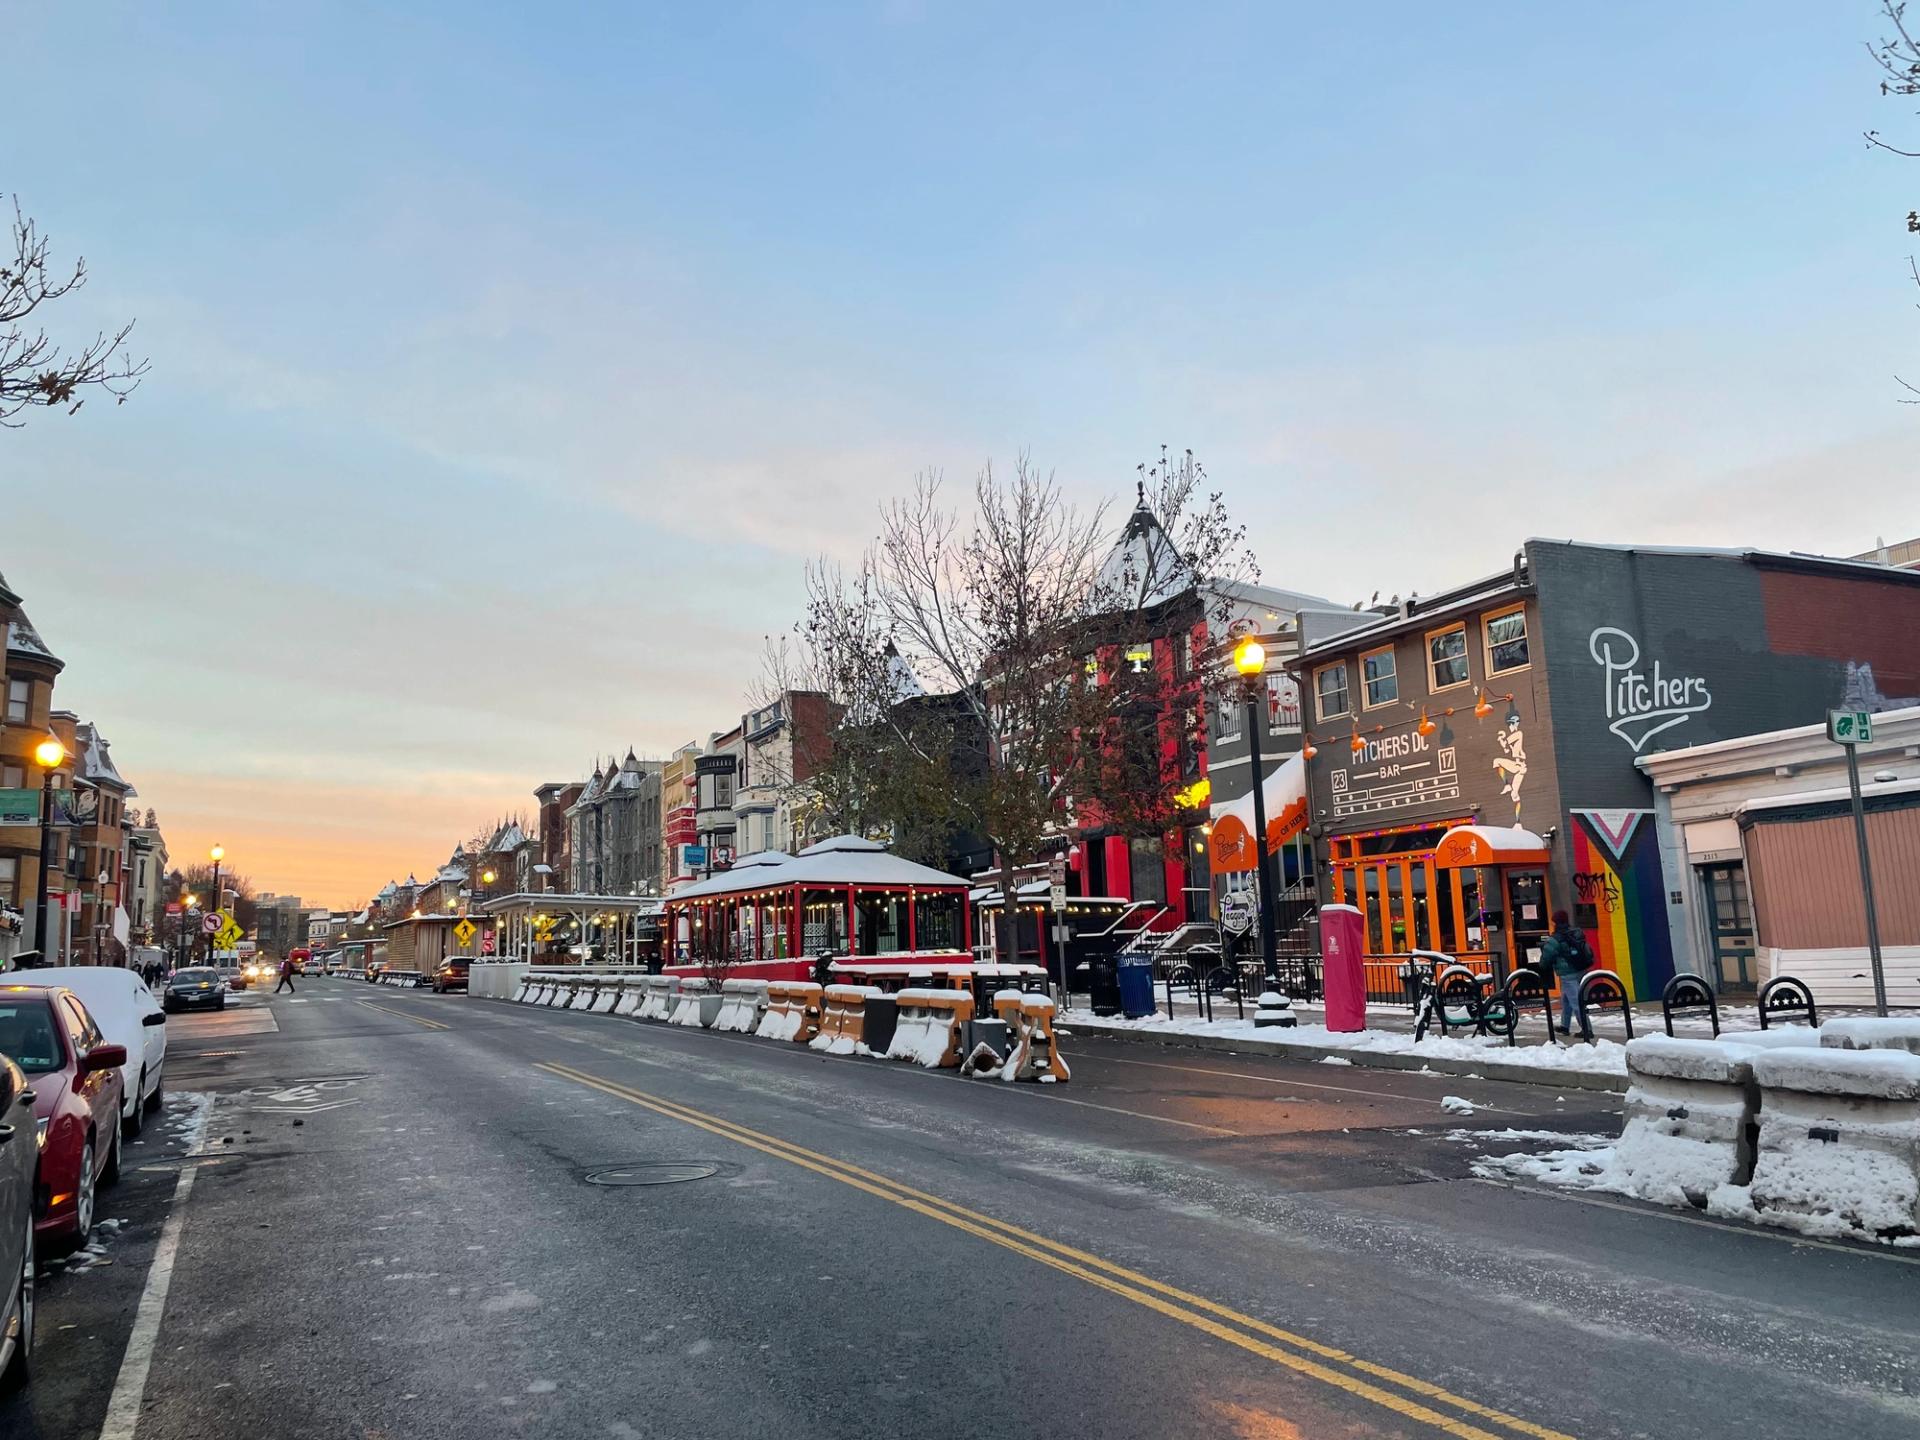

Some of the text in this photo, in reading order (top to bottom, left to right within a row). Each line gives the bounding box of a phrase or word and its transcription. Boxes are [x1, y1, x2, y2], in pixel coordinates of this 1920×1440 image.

[1589, 626, 1712, 752] Pitchers
[1440, 751, 1453, 769] 17
[1379, 764, 1402, 779] BAR
[1333, 772, 1346, 790] 23
